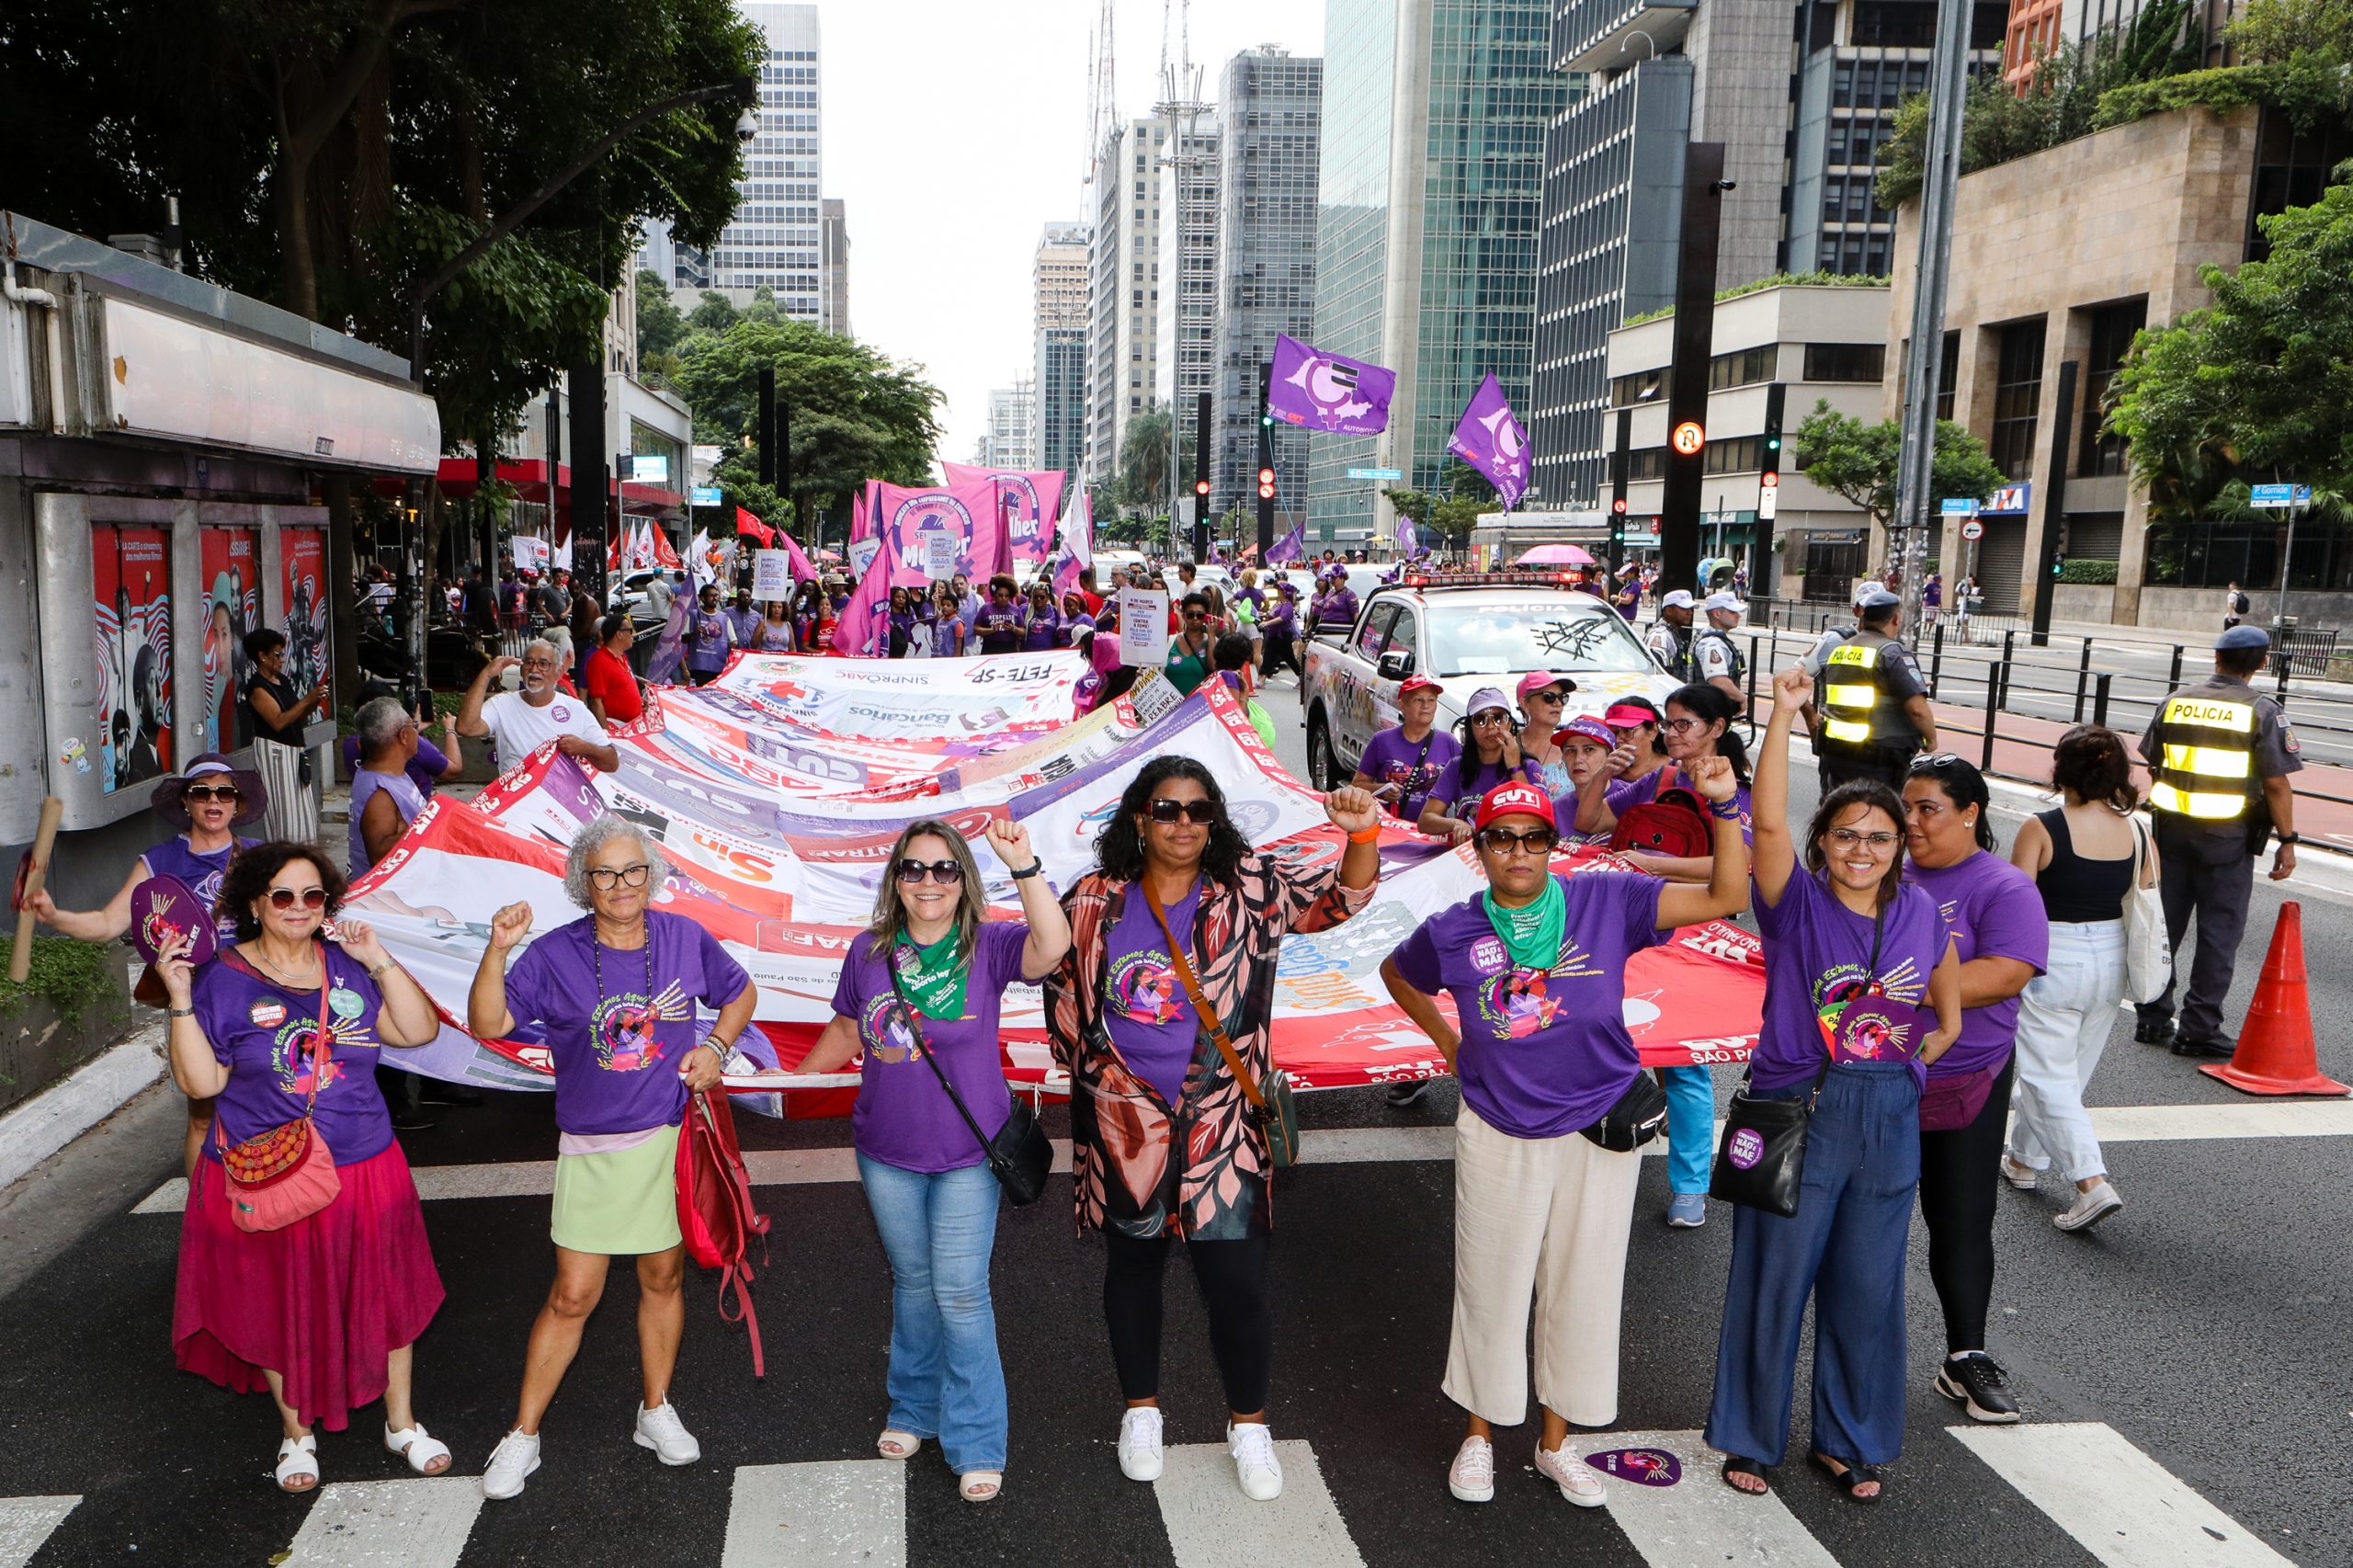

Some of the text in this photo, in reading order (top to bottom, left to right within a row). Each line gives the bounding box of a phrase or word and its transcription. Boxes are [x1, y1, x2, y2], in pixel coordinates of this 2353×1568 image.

[1766, 475, 1775, 483] 50
[693, 488, 711, 496] Paulista
[2262, 486, 2289, 494] Gomide
[132, 552, 151, 561] melhores
[1479, 604, 1568, 614] POLÍCIA
[972, 664, 1052, 684] FETE-SP
[1148, 691, 1177, 722] REABRE
[2174, 705, 2234, 722] POLICIA
[775, 745, 860, 781] CUT
[1493, 789, 1537, 805] CUT
[671, 815, 789, 858] DEMOCRACIA
[1708, 922, 1742, 942] PAULO
[1475, 940, 1499, 950] CRIANÇA
[1110, 950, 1144, 974] Estamos
[1823, 963, 1859, 981] Estamos
[1115, 962, 1134, 985] Mulheres
[1155, 961, 1166, 970] por
[911, 975, 937, 993] Aborto
[1477, 968, 1509, 1020] Ainda Estamos
[1824, 976, 1850, 993] Mulheres
[862, 991, 895, 1039] Ainda Estamo
[870, 1001, 889, 1021] Mulheres
[275, 1019, 299, 1046] Estamos
[589, 1025, 600, 1049] Ainda
[273, 1046, 281, 1073] Ainda
